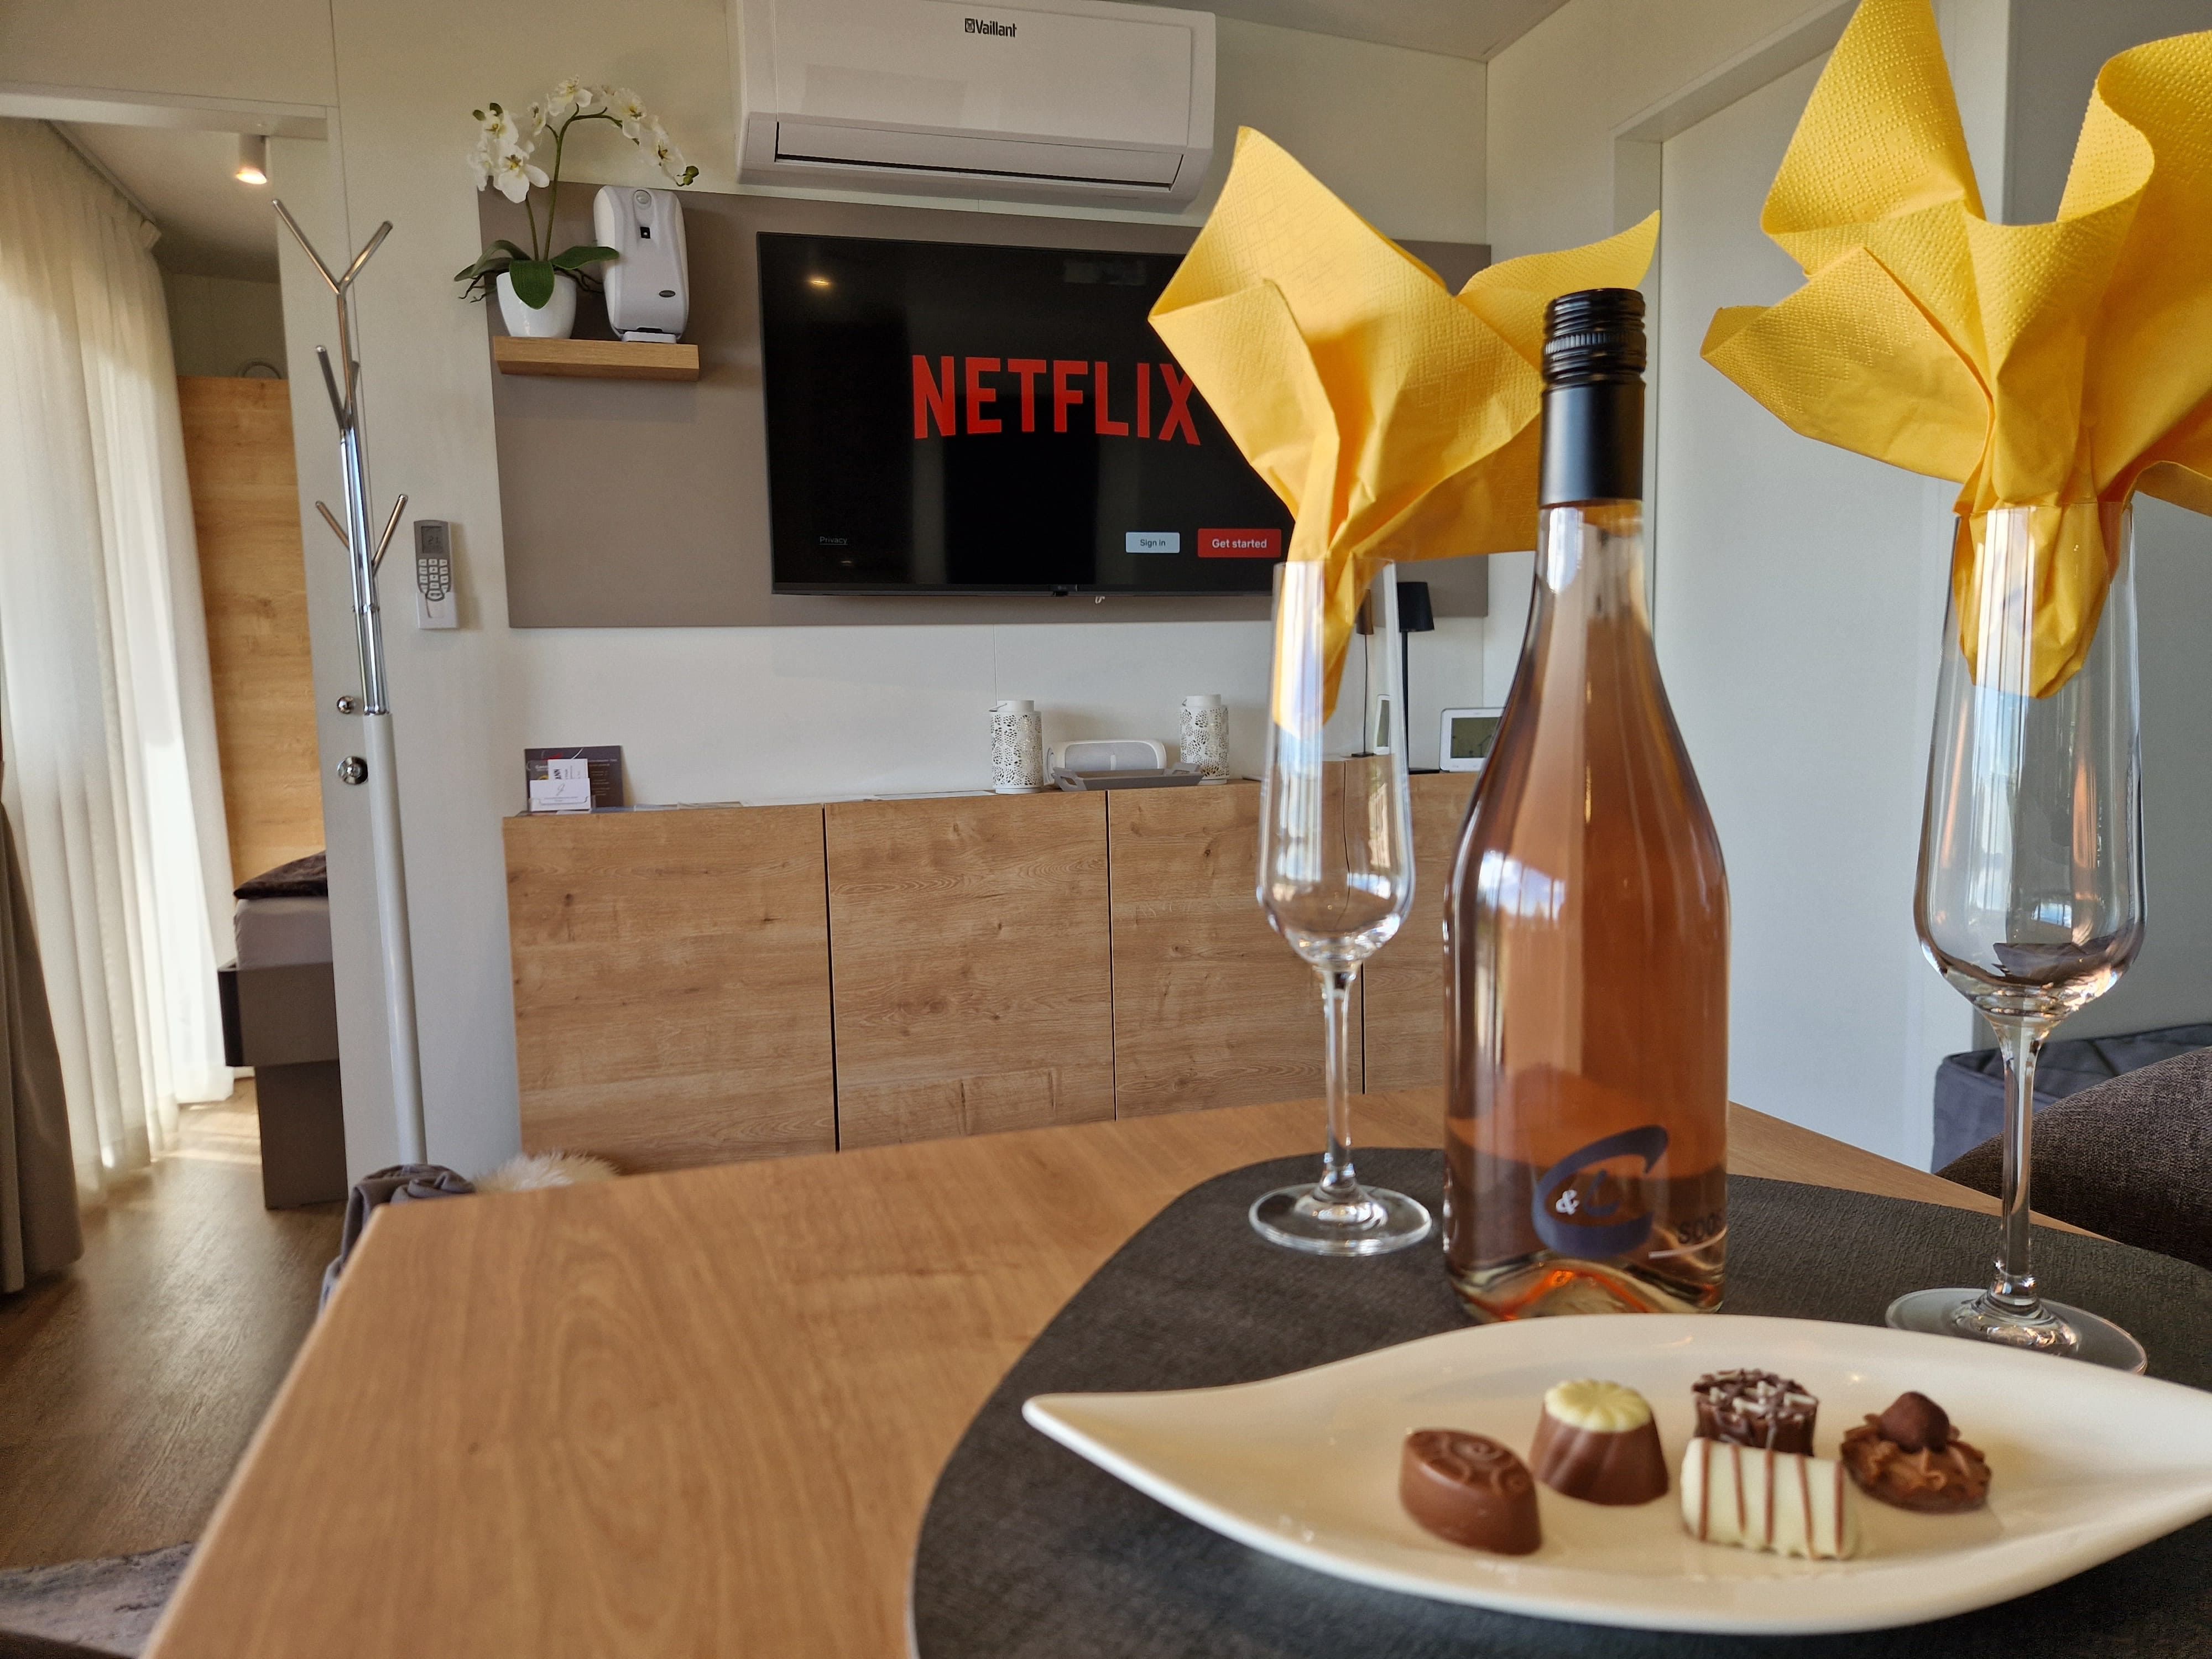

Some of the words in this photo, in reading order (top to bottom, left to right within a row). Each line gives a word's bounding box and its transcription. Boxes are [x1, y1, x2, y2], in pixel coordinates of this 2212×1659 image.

[975, 19, 1017, 38] Vaillant
[912, 354, 1201, 446] NETFLIX
[819, 536, 848, 545] Privacy
[1140, 539, 1157, 548] Sign
[1212, 539, 1230, 549] Get
[1232, 539, 1267, 549] started
